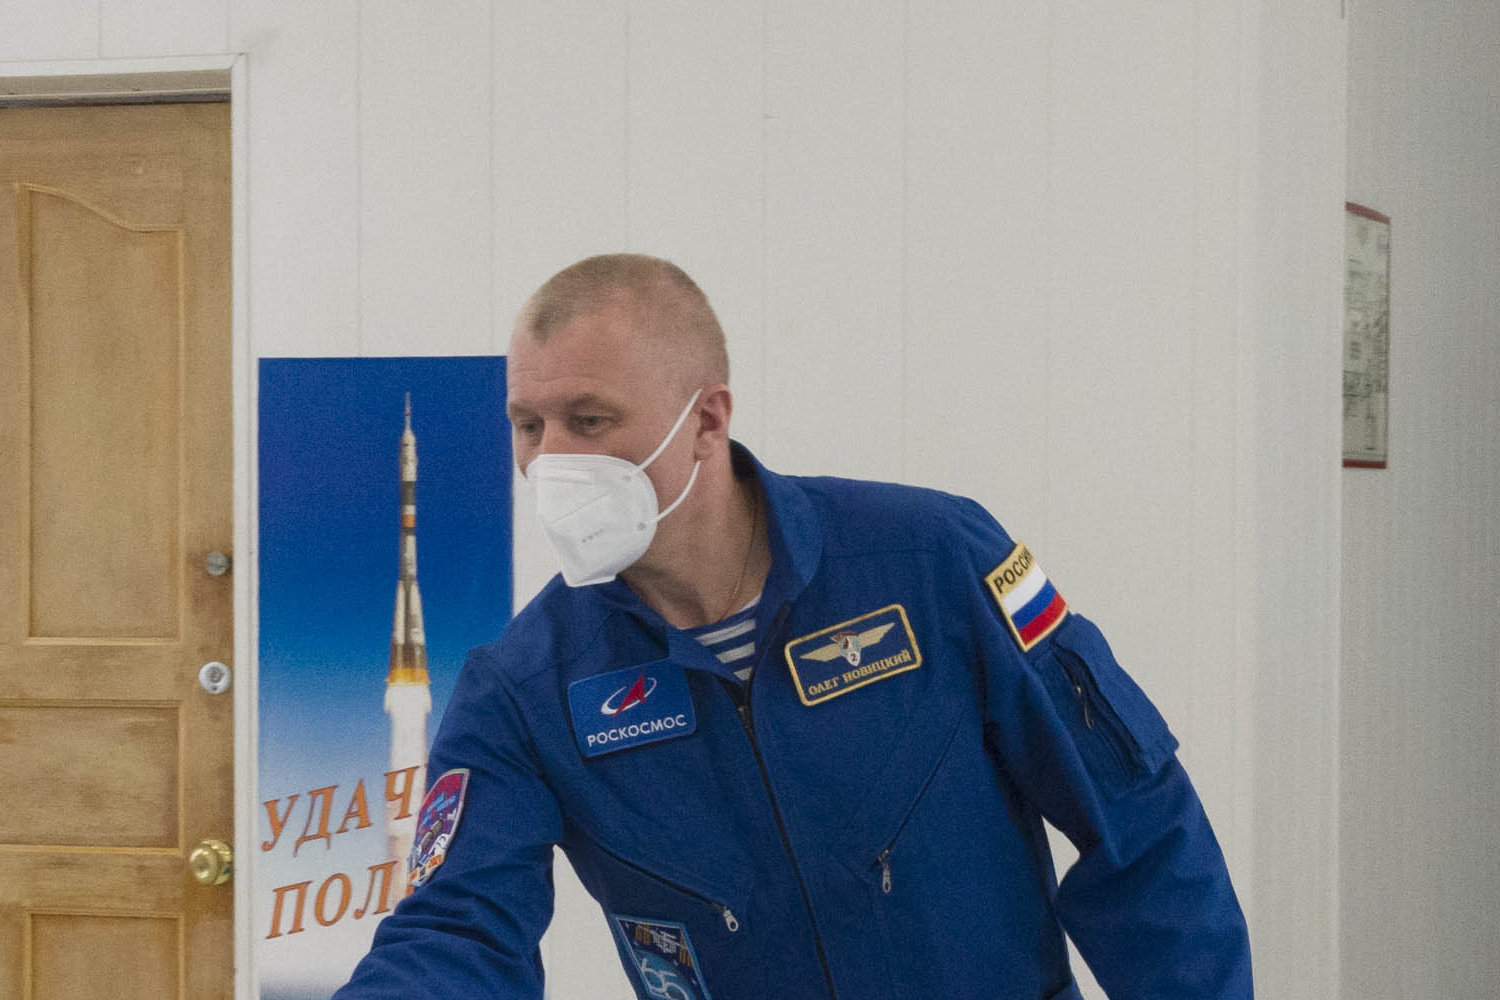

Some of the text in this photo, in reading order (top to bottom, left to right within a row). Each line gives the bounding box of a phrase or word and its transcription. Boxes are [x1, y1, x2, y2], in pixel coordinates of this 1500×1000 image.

[993, 544, 1034, 594] РОССИ
[808, 648, 912, 696] ОЛЕГ НОВИЦКИЙ
[587, 713, 688, 748] РОСКОСМОС
[261, 764, 422, 858] УДАЧ
[266, 860, 415, 940] ПОЛ
